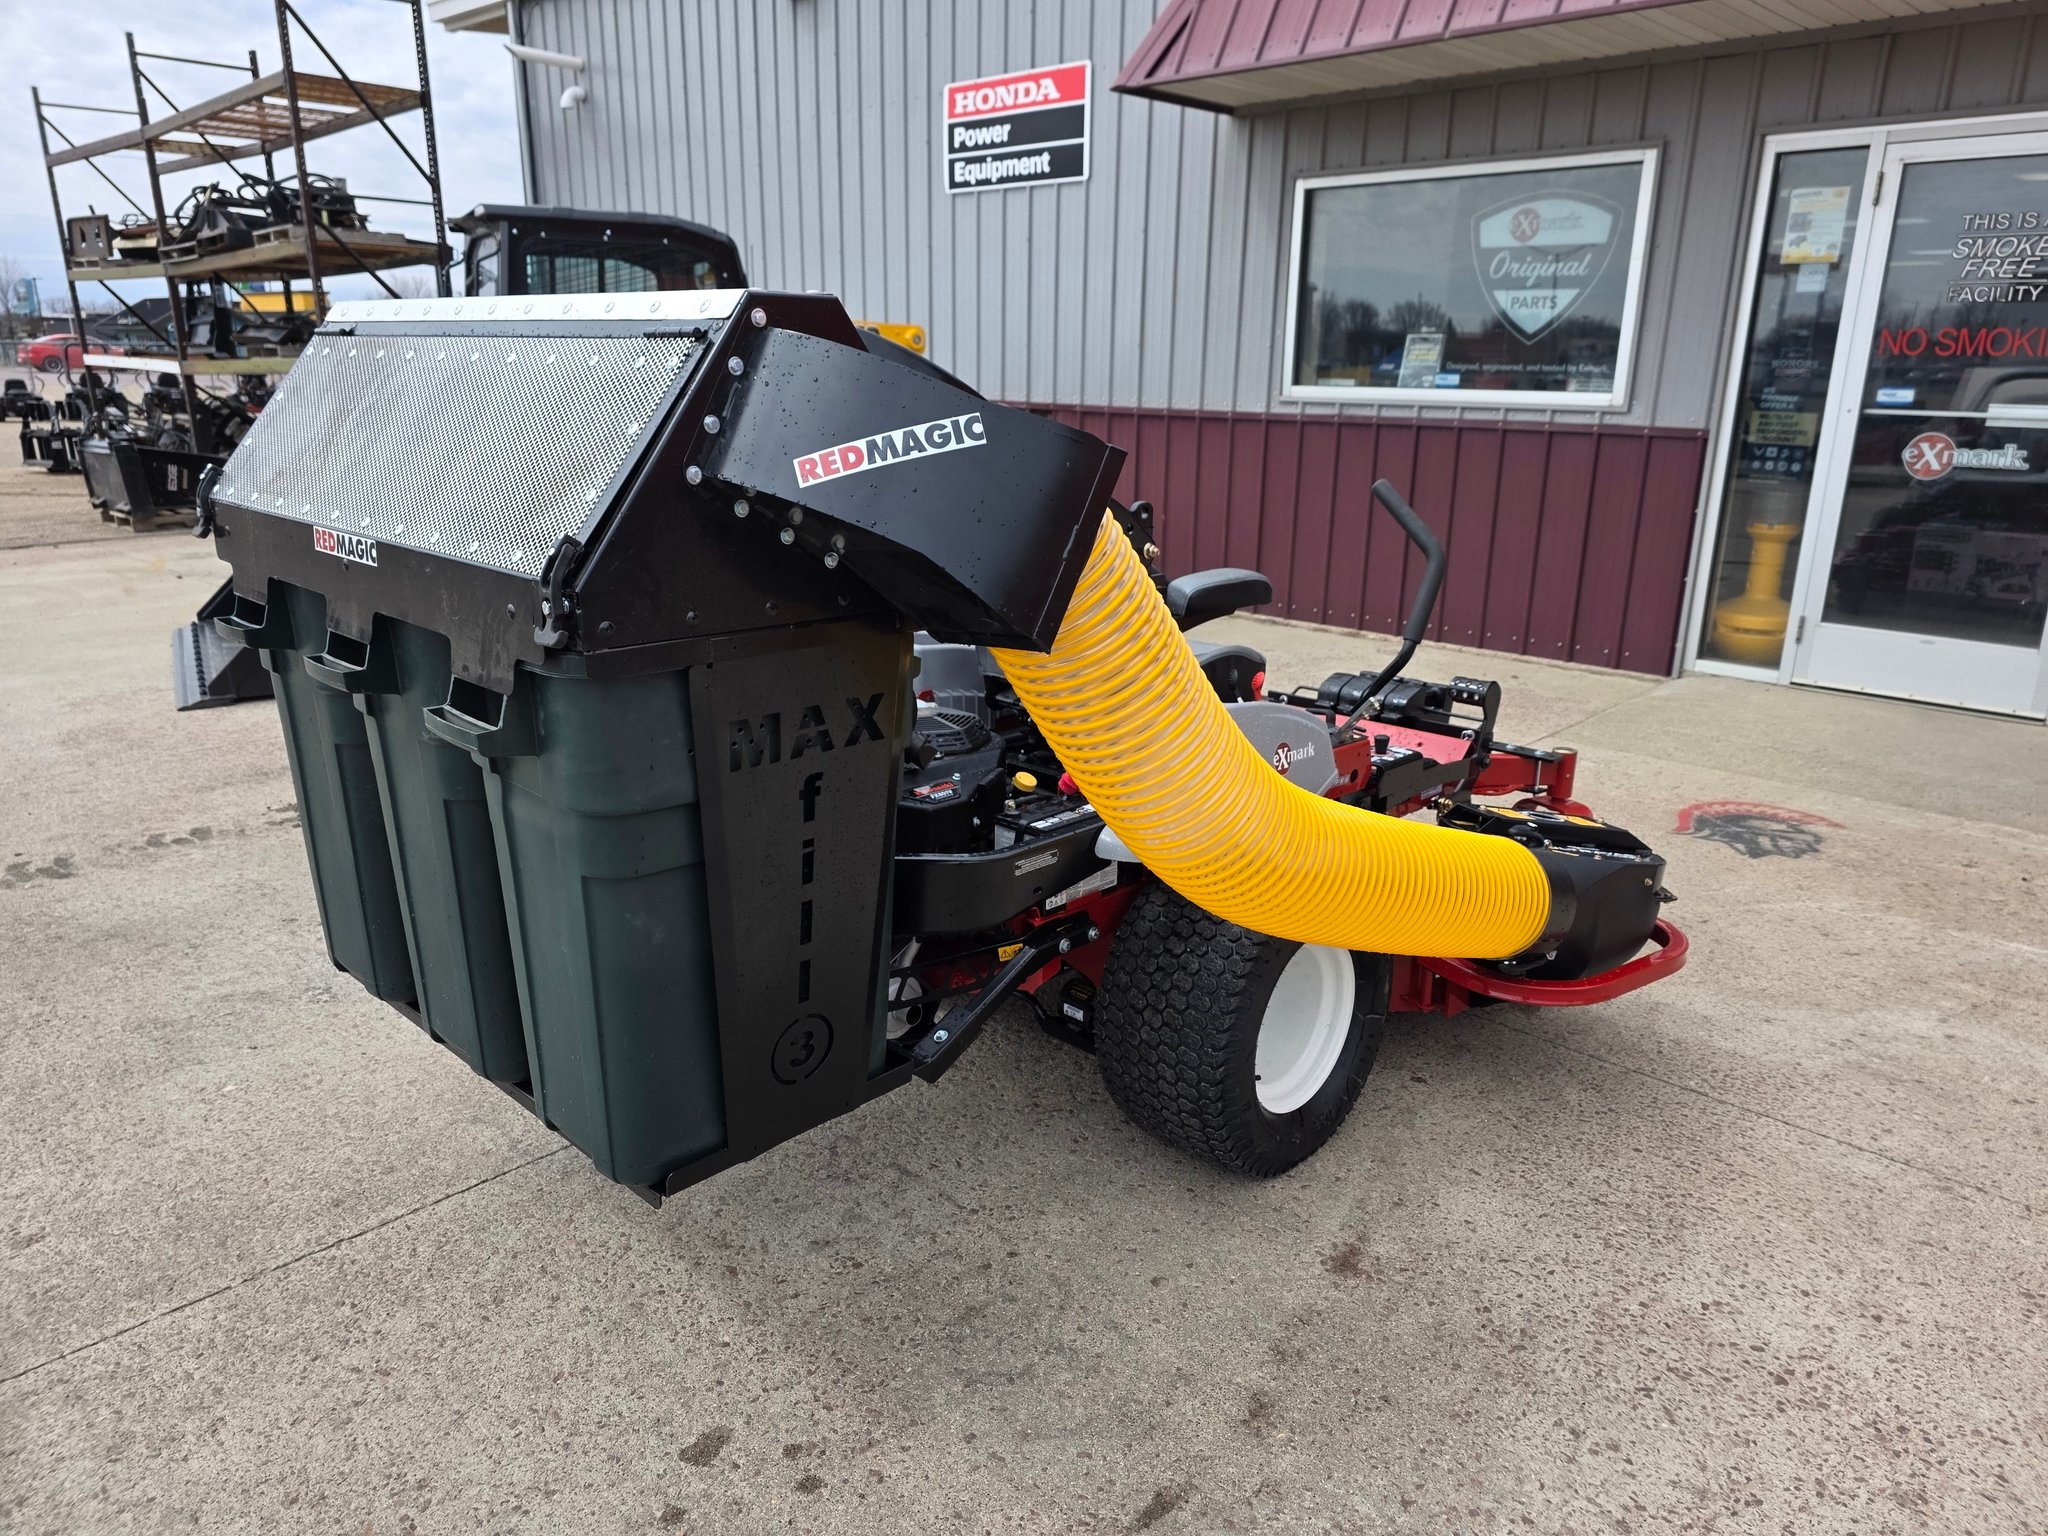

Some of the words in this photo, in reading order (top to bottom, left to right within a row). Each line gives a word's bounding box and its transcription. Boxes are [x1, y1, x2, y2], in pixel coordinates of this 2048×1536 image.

[953, 77, 1061, 114] HONDA
[953, 123, 1011, 149] Power
[953, 151, 1051, 185] Equipment
[1962, 213, 2011, 231] THIS
[2017, 211, 2038, 229] IS
[1952, 236, 2048, 259] SMOKE
[1489, 250, 1593, 287] Original
[1960, 256, 2041, 279] FREE
[1510, 295, 1558, 310] PARTS
[1946, 285, 2044, 304] FACILITY
[1878, 328, 1928, 357] NO
[1935, 327, 2048, 358] SMOKI
[1526, 362, 1540, 371] and
[1902, 436, 2030, 476] eXmark
[729, 692, 885, 773] MAX
[1273, 741, 1315, 772] eXmark
[789, 1029, 816, 1068] 3
